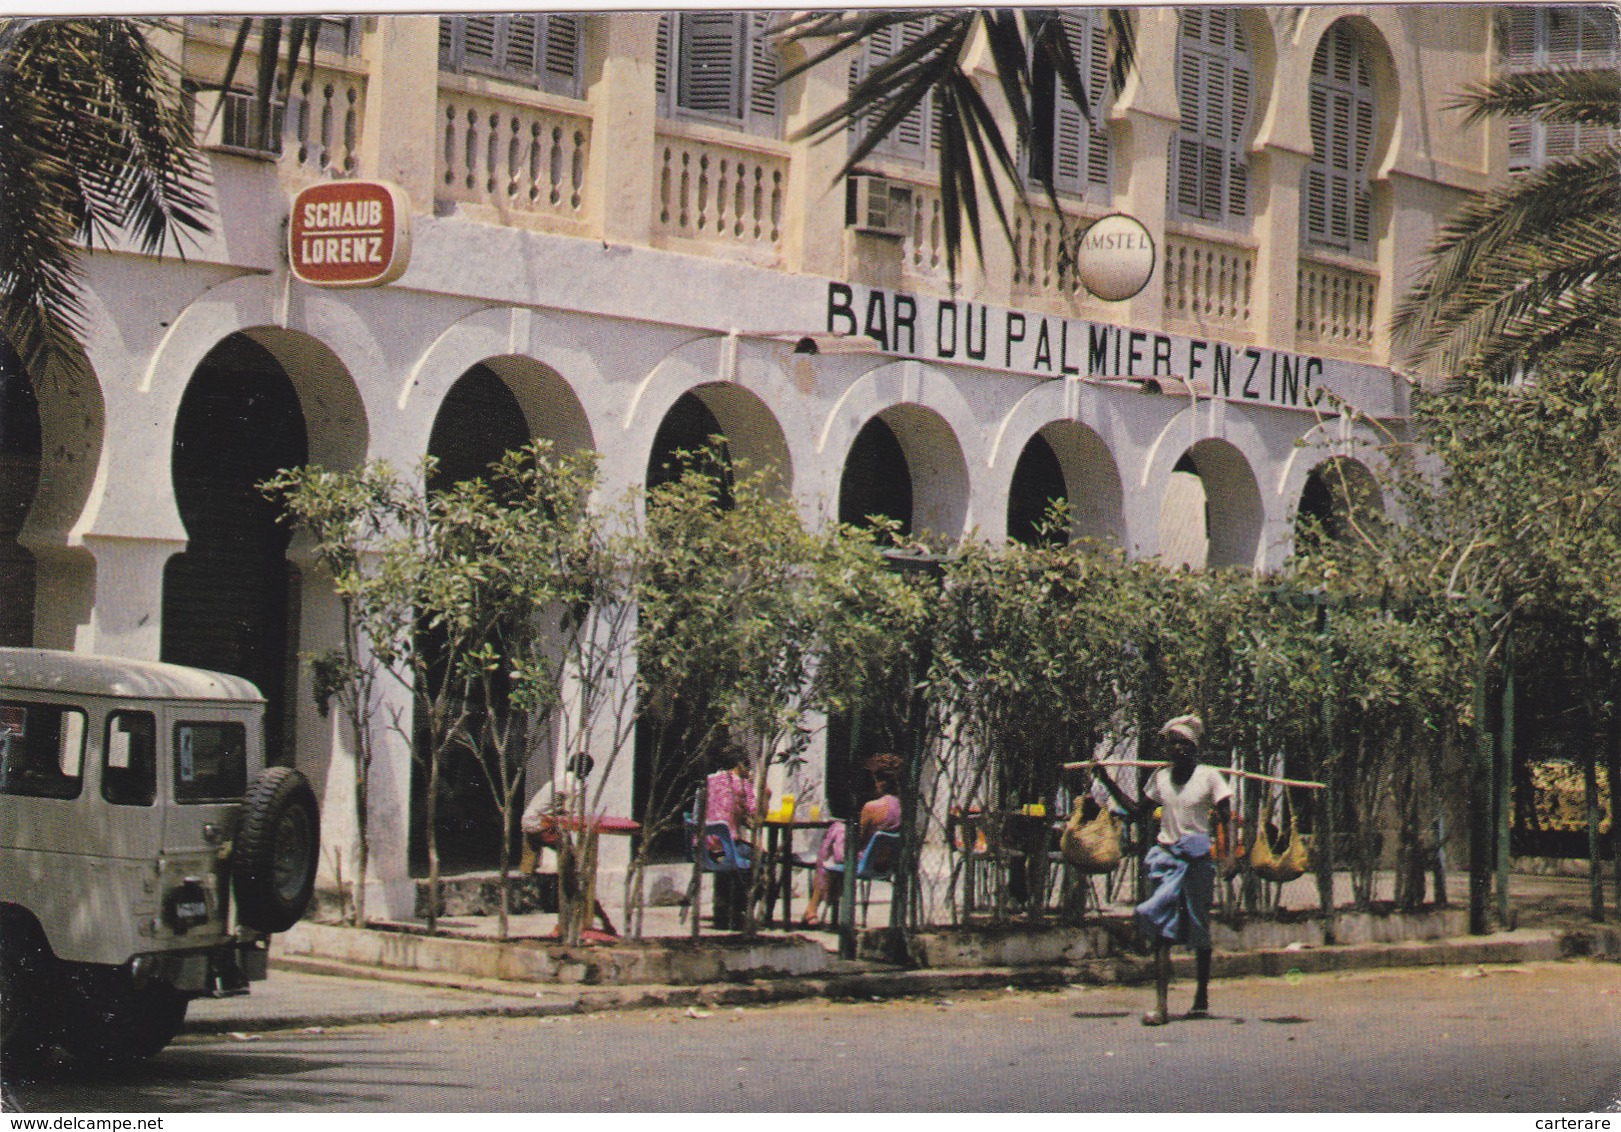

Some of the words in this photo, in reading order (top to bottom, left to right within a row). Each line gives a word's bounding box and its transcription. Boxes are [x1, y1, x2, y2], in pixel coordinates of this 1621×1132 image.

[303, 200, 382, 228] SCHAUB
[301, 236, 382, 264] LORENZ
[1082, 232, 1148, 250] AMSTEL
[827, 281, 917, 354] BAR
[936, 300, 987, 361] DU
[1006, 311, 1172, 376] PALMIER
[1243, 349, 1324, 407] ZINC
